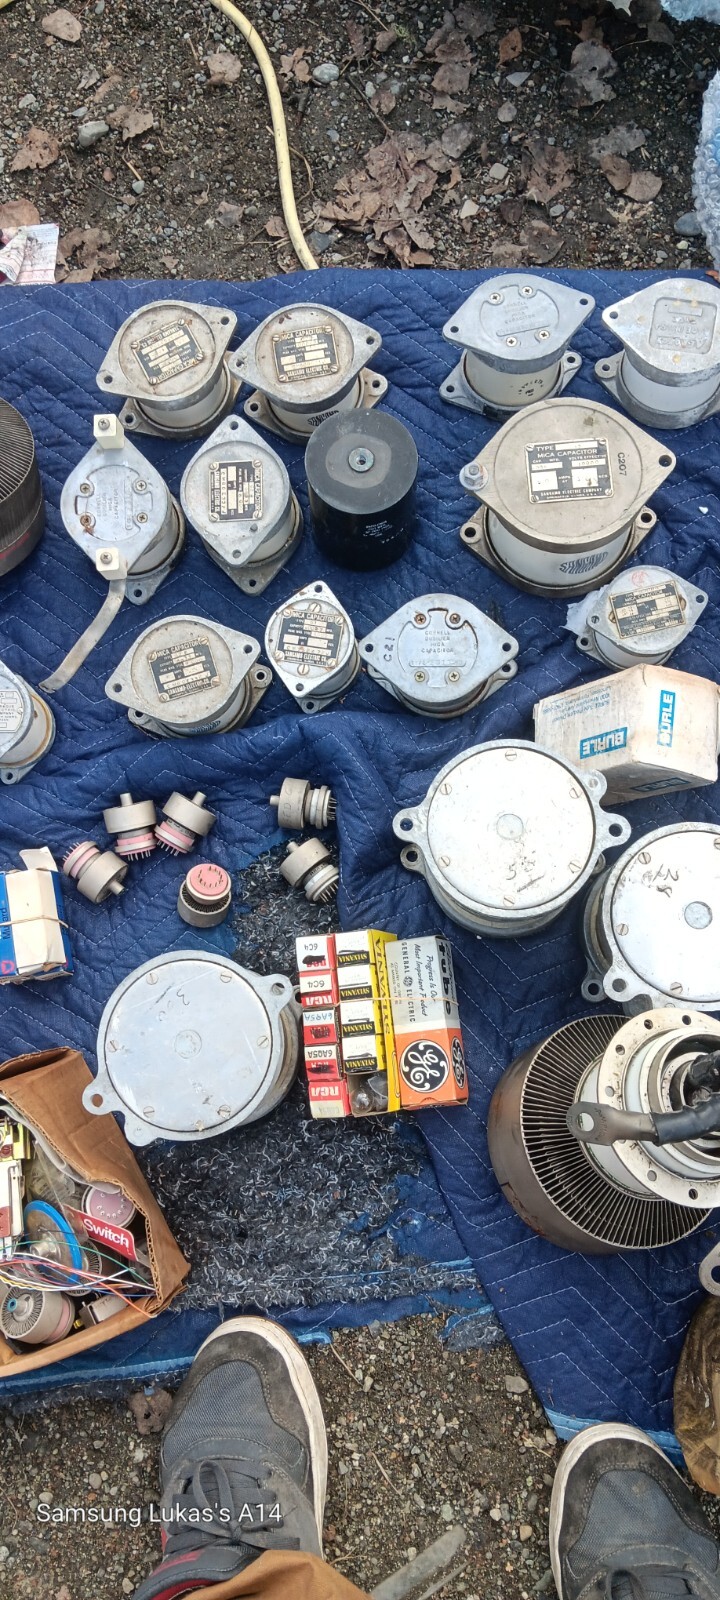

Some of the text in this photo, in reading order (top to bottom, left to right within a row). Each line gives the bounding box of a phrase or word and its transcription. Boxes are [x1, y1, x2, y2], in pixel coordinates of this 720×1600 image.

[558, 448, 598, 457] CAPACITOR
[617, 452, 627, 476] C207
[660, 694, 674, 744] BURLE
[583, 730, 624, 756] BURLE
[338, 954, 368, 962] SYLVANIA
[402, 942, 410, 974] GENERAL
[425, 956, 434, 982] Progress
[416, 960, 424, 992] Important
[438, 942, 451, 1014] tube
[307, 980, 325, 988] 6C4
[340, 988, 370, 997] SYLVANIA
[306, 994, 332, 1006] RCA
[343, 1023, 372, 1032] SYLVANIA
[308, 1050, 332, 1058] 6AQ5A
[346, 1059, 375, 1068] SYLVANIA
[312, 1086, 338, 1096] RCA
[84, 1218, 130, 1249] Switch
